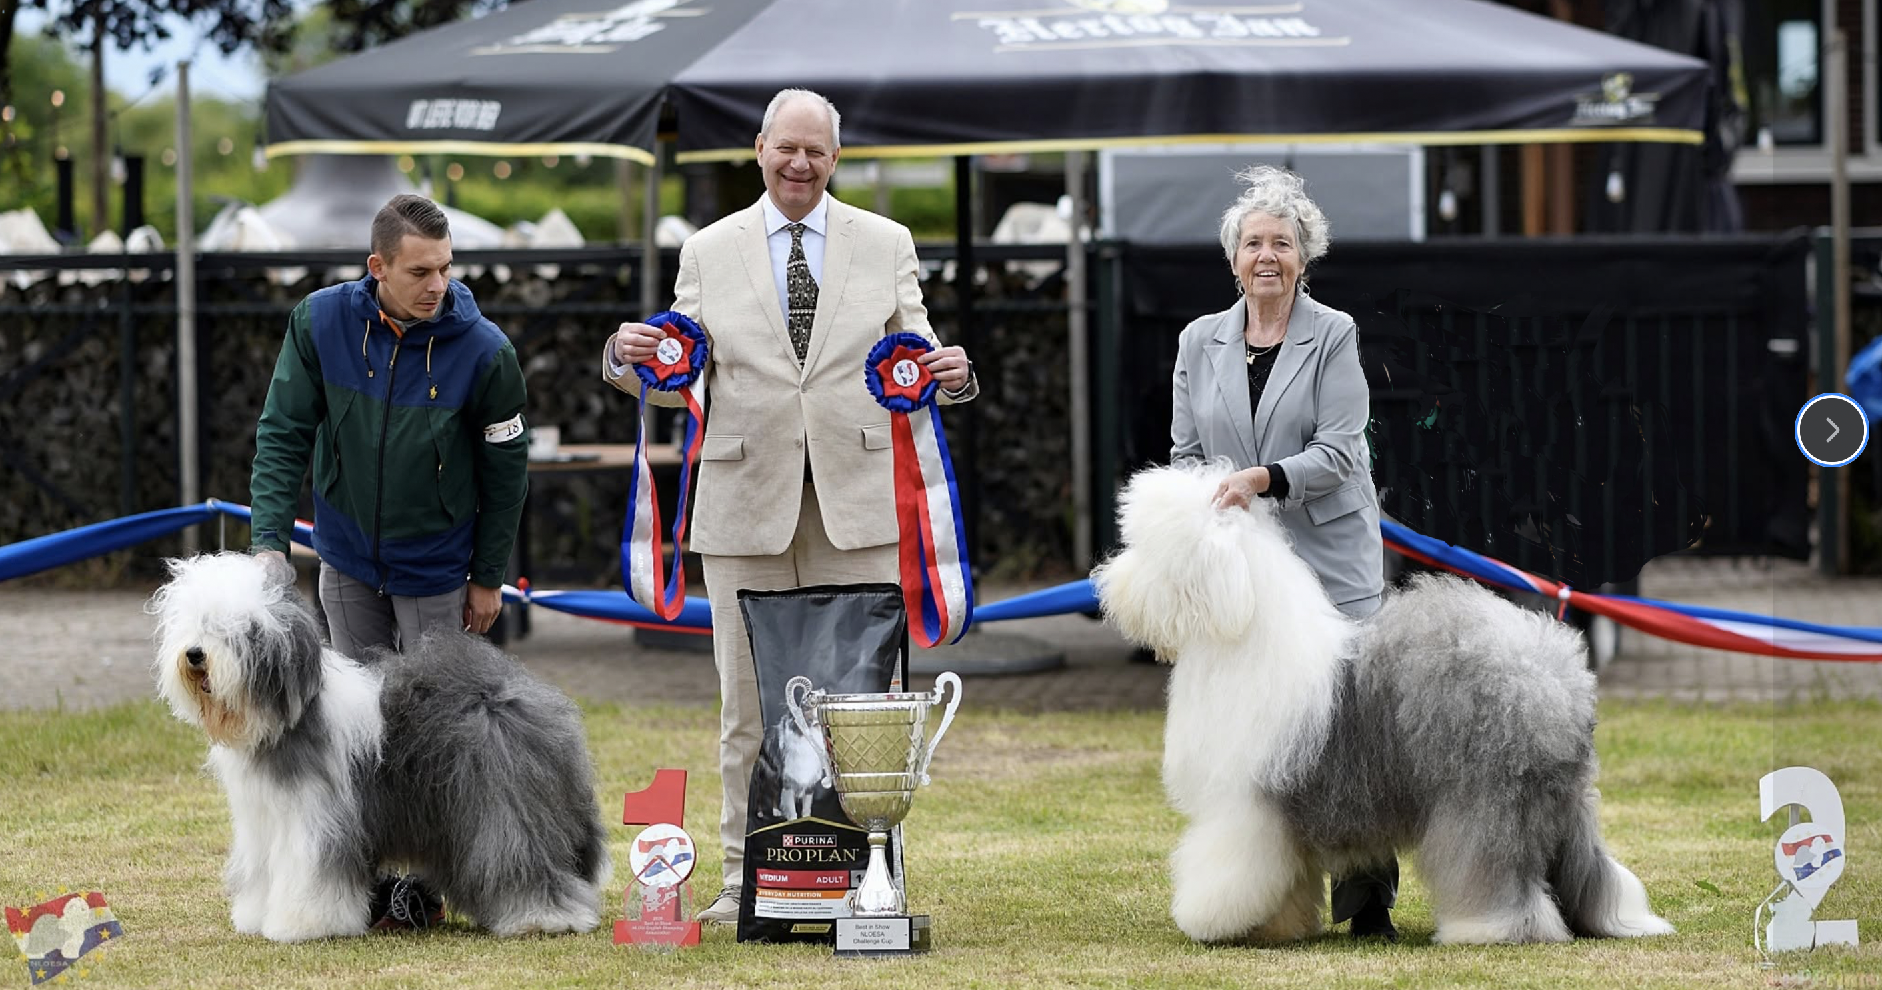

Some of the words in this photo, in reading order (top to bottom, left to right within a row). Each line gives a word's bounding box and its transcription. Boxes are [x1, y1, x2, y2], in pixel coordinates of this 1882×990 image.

[506, 422, 519, 437] 18
[794, 836, 834, 845] PURINA
[766, 847, 802, 862] PRO
[805, 848, 857, 862] PLAN
[759, 873, 788, 882] MEDIUM
[816, 876, 844, 884] ADULT
